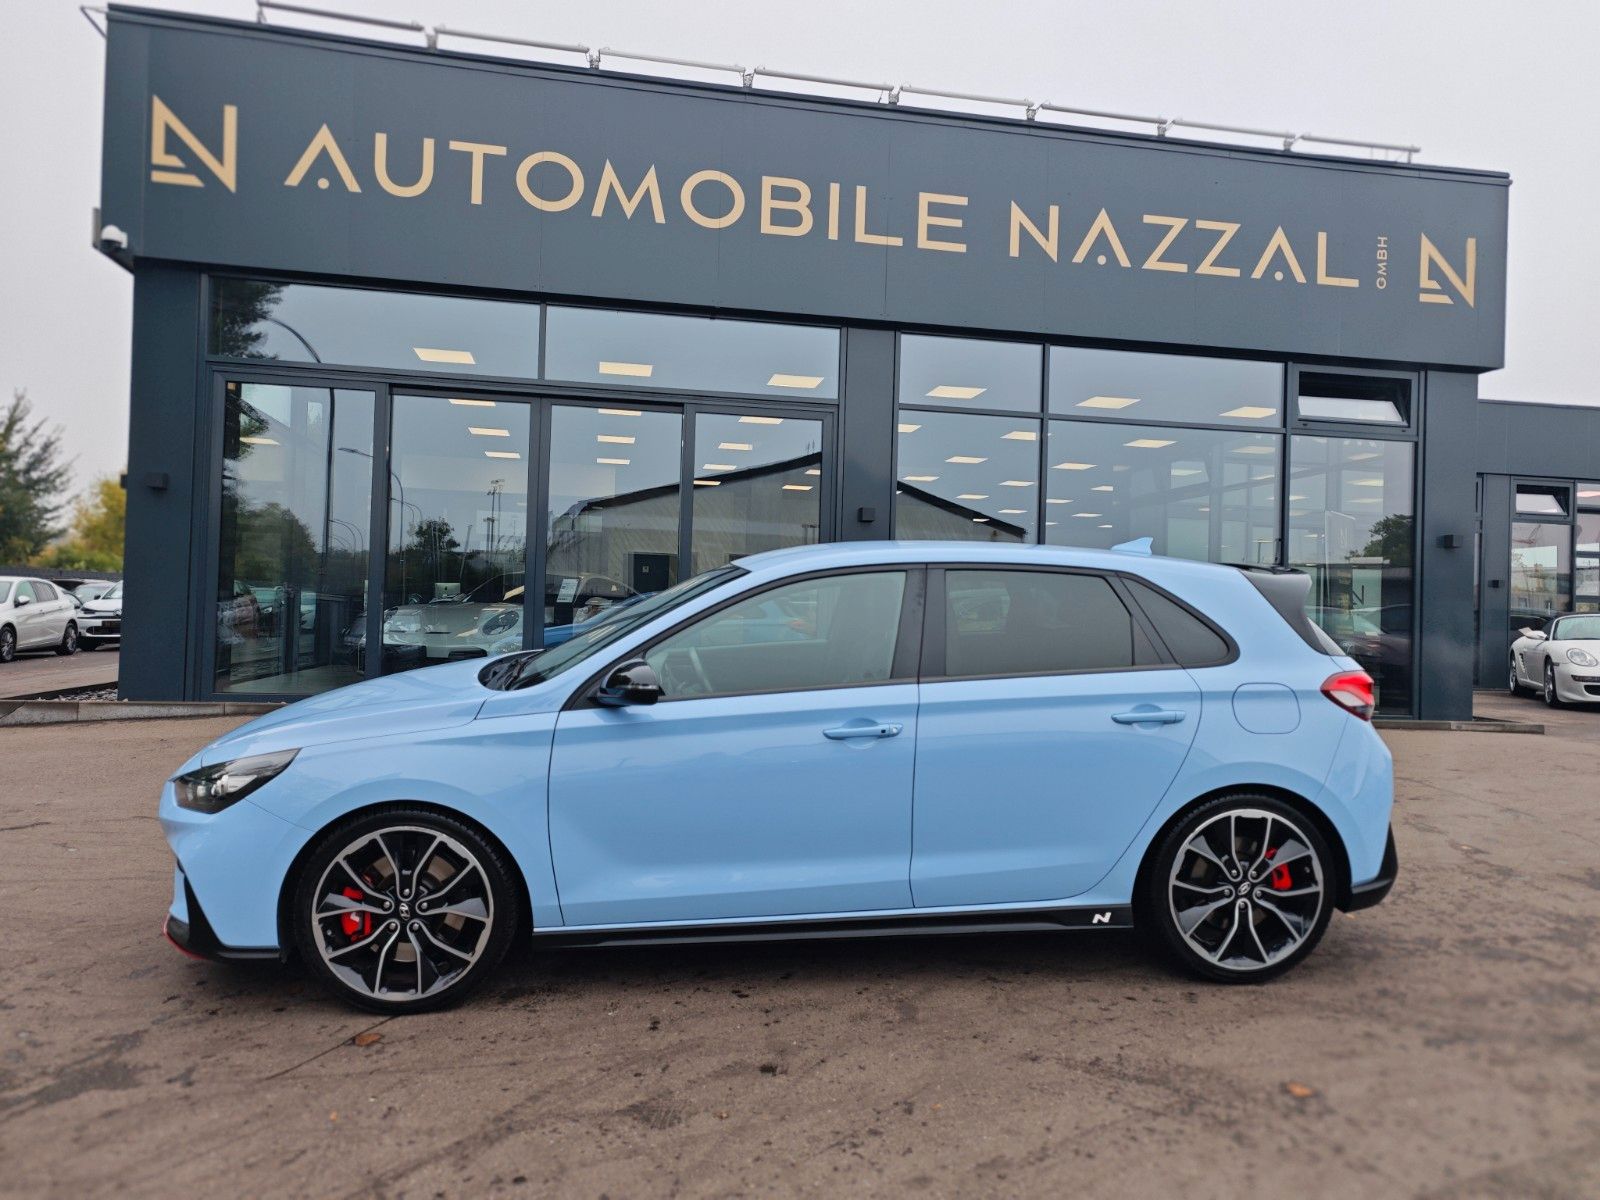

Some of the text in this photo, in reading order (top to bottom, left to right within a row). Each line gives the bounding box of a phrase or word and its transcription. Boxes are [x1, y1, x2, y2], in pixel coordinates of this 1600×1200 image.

[285, 124, 1361, 288] AUTOMOBILE NAZZAL
[1375, 235, 1389, 290] GMBH
[1092, 911, 1112, 924] N
